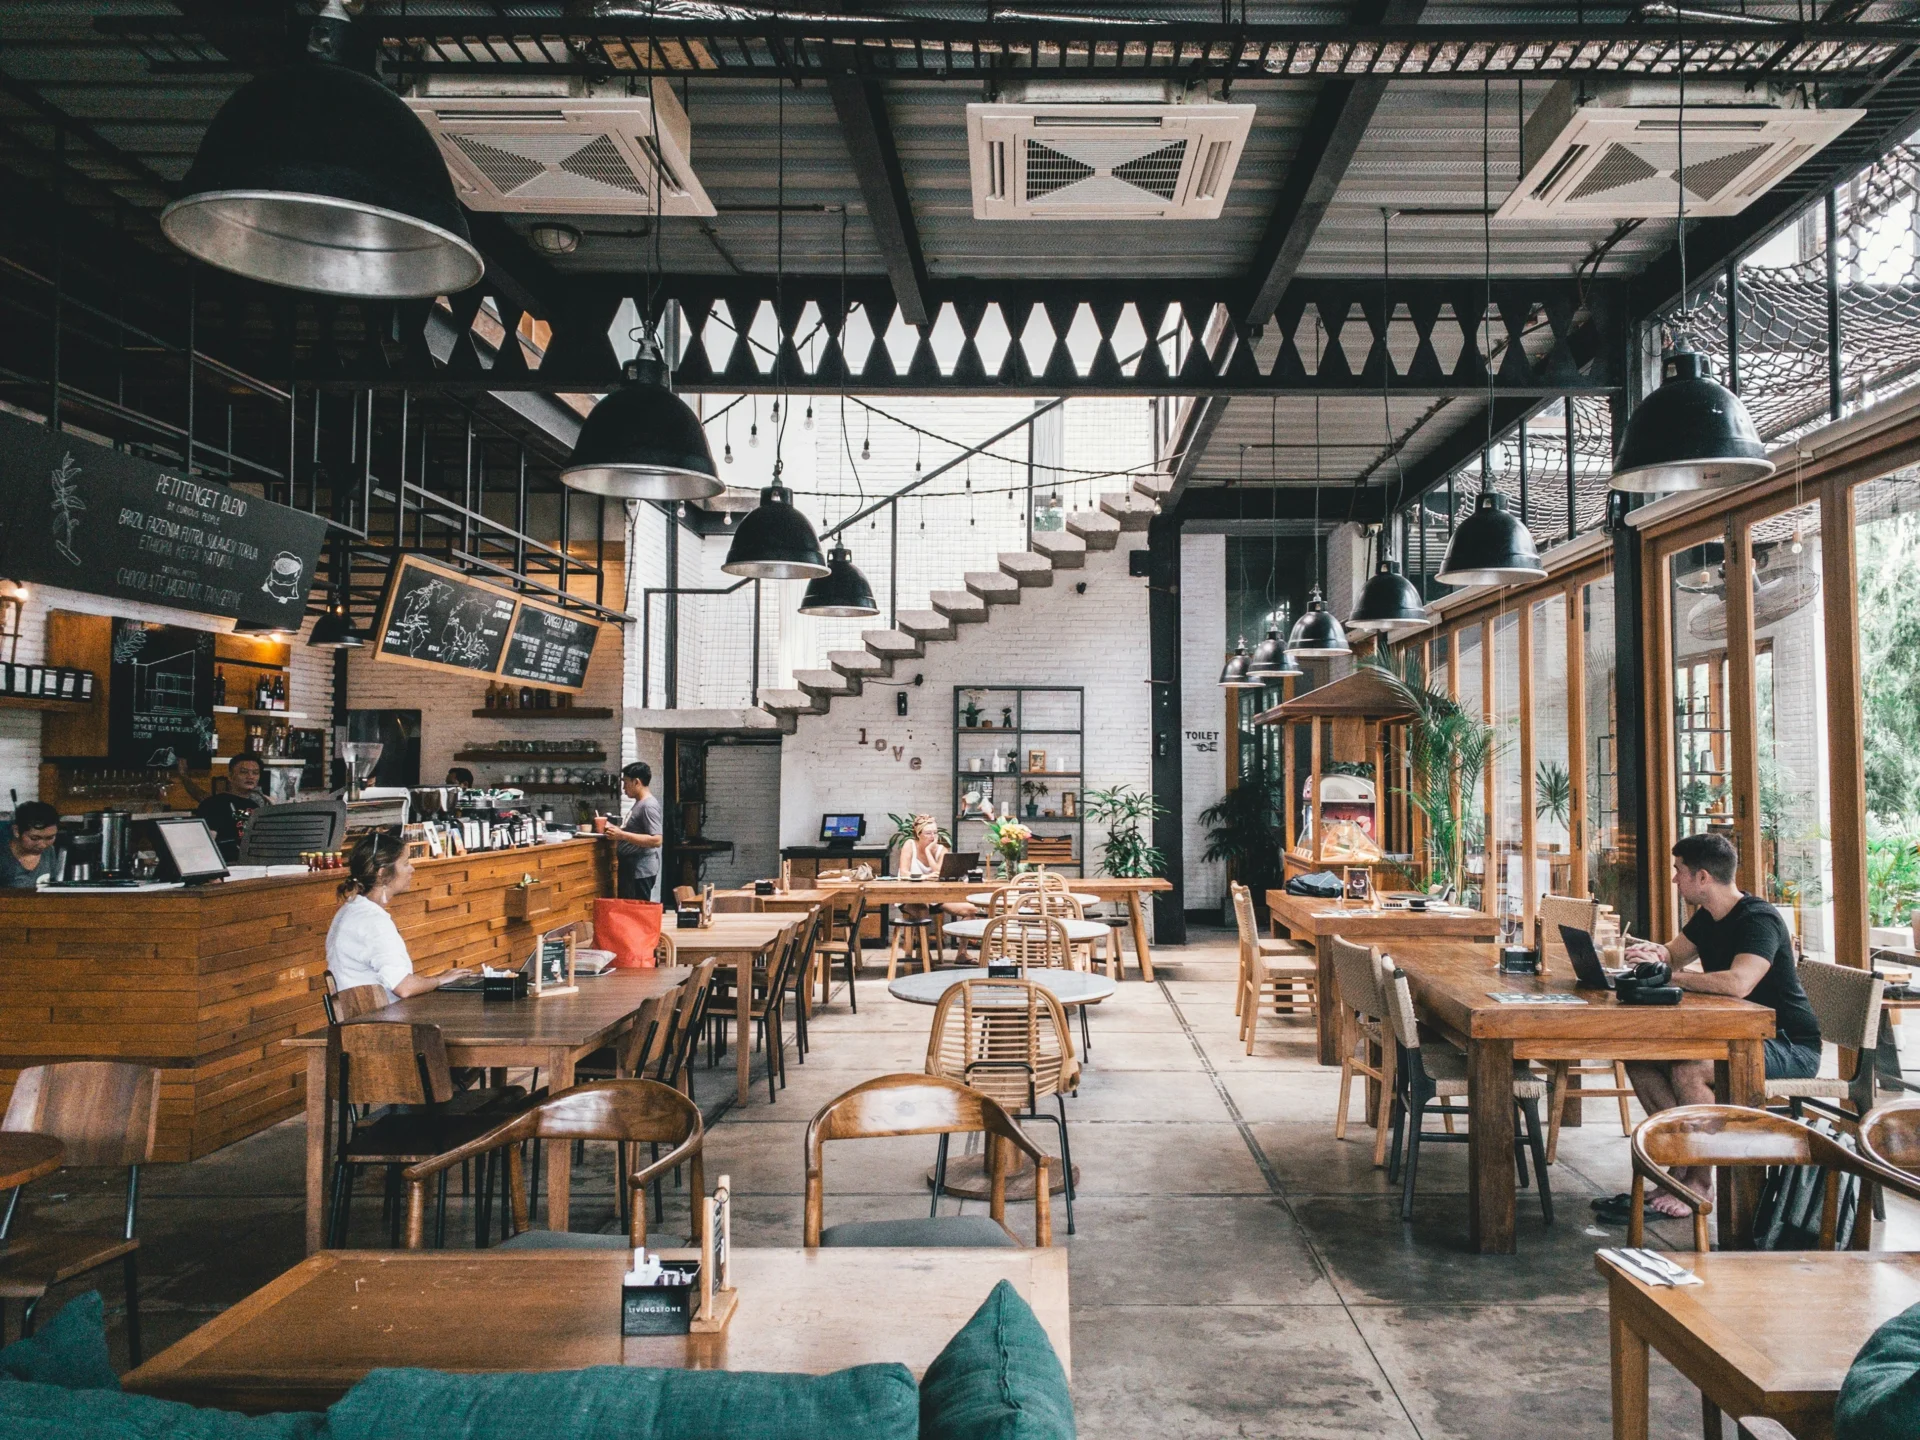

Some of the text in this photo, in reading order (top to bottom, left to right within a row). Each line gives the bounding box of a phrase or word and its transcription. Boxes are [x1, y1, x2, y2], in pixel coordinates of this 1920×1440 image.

[155, 473, 248, 517] PETITENGET BLEND
[118, 508, 144, 529] BRAZIL
[176, 504, 200, 518] CURIOUS
[201, 512, 221, 526] PEOPLE
[1185, 731, 1220, 740] TOILET
[858, 727, 922, 770] love
